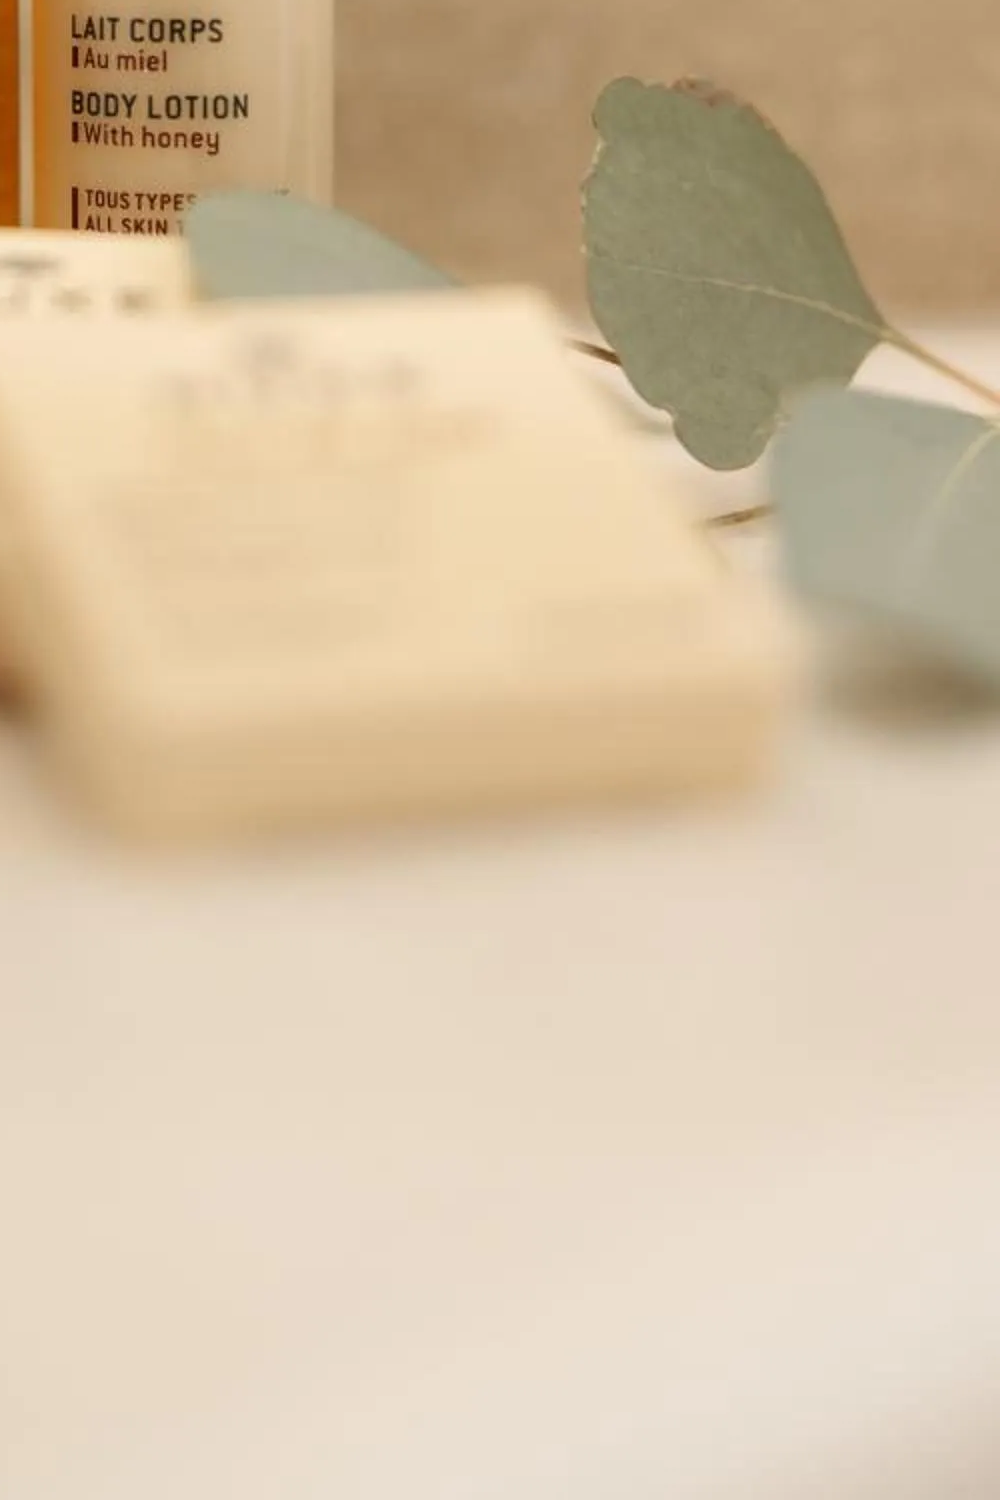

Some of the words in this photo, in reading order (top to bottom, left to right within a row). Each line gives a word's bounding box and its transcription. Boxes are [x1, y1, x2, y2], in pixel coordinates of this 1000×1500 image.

[71, 14, 120, 41] LAIT
[129, 18, 223, 44] CORPS
[83, 48, 110, 70] Au
[117, 50, 168, 72] miel
[71, 89, 137, 120] BODY
[147, 94, 249, 120] LOTION
[83, 121, 134, 148] With
[141, 126, 220, 156] honey
[84, 189, 131, 210] TOUS
[85, 215, 117, 233] ALL
[121, 217, 169, 236] SKIN
